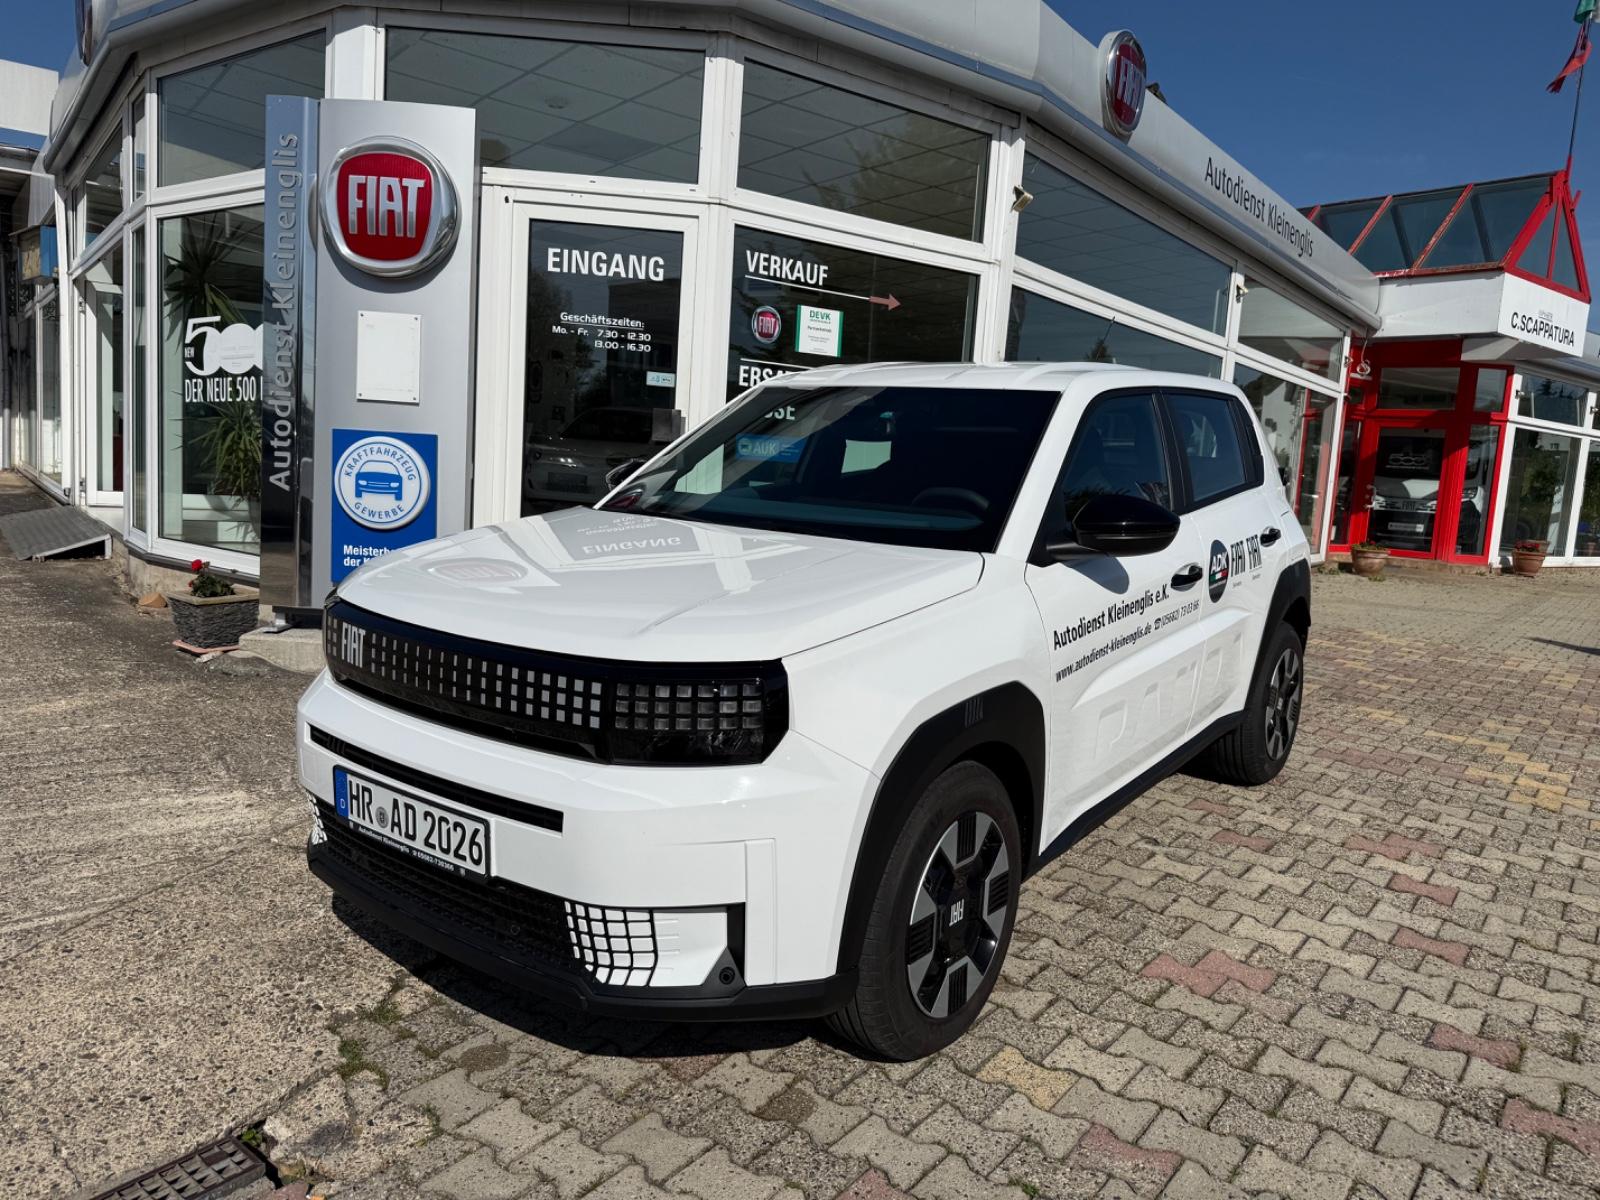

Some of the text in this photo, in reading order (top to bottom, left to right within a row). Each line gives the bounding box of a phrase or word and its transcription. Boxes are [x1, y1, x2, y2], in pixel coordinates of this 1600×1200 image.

[347, 174, 426, 238] FIAT
[1205, 157, 1313, 257] Autodienst Kleinenglis
[547, 247, 665, 282] EINGANG
[746, 249, 829, 287] VERKAUF
[269, 133, 303, 492] Autodienst Kleinenglis
[560, 311, 645, 328] Geschäftszeiten:
[758, 316, 776, 335] FIAT
[808, 310, 831, 321] DEVK
[1511, 311, 1575, 347] C.SCAPPATURA
[551, 325, 569, 335] Mo.
[577, 327, 589, 337] Fr.
[597, 329, 619, 339] 7.30
[627, 332, 652, 342] 12.30
[594, 340, 619, 350] 13.00
[626, 343, 652, 353] 16.30
[184, 378, 204, 403] DER
[206, 377, 233, 402] NEUE
[235, 375, 257, 402] 500
[344, 446, 417, 481] KRAFTFAHRZEUG
[354, 501, 405, 520] GEWERBE
[343, 557, 361, 567] der
[1211, 551, 1228, 575] ADK
[1230, 533, 1262, 578] FIAT FIAT
[1053, 584, 1170, 650] Autodienst Kleinenglis e.K.
[341, 621, 366, 669] FIAT
[1055, 623, 1152, 683] www.autodienst-kleinenglis.de
[349, 780, 374, 824] HR
[390, 798, 417, 842] AD
[423, 810, 483, 866] 2026
